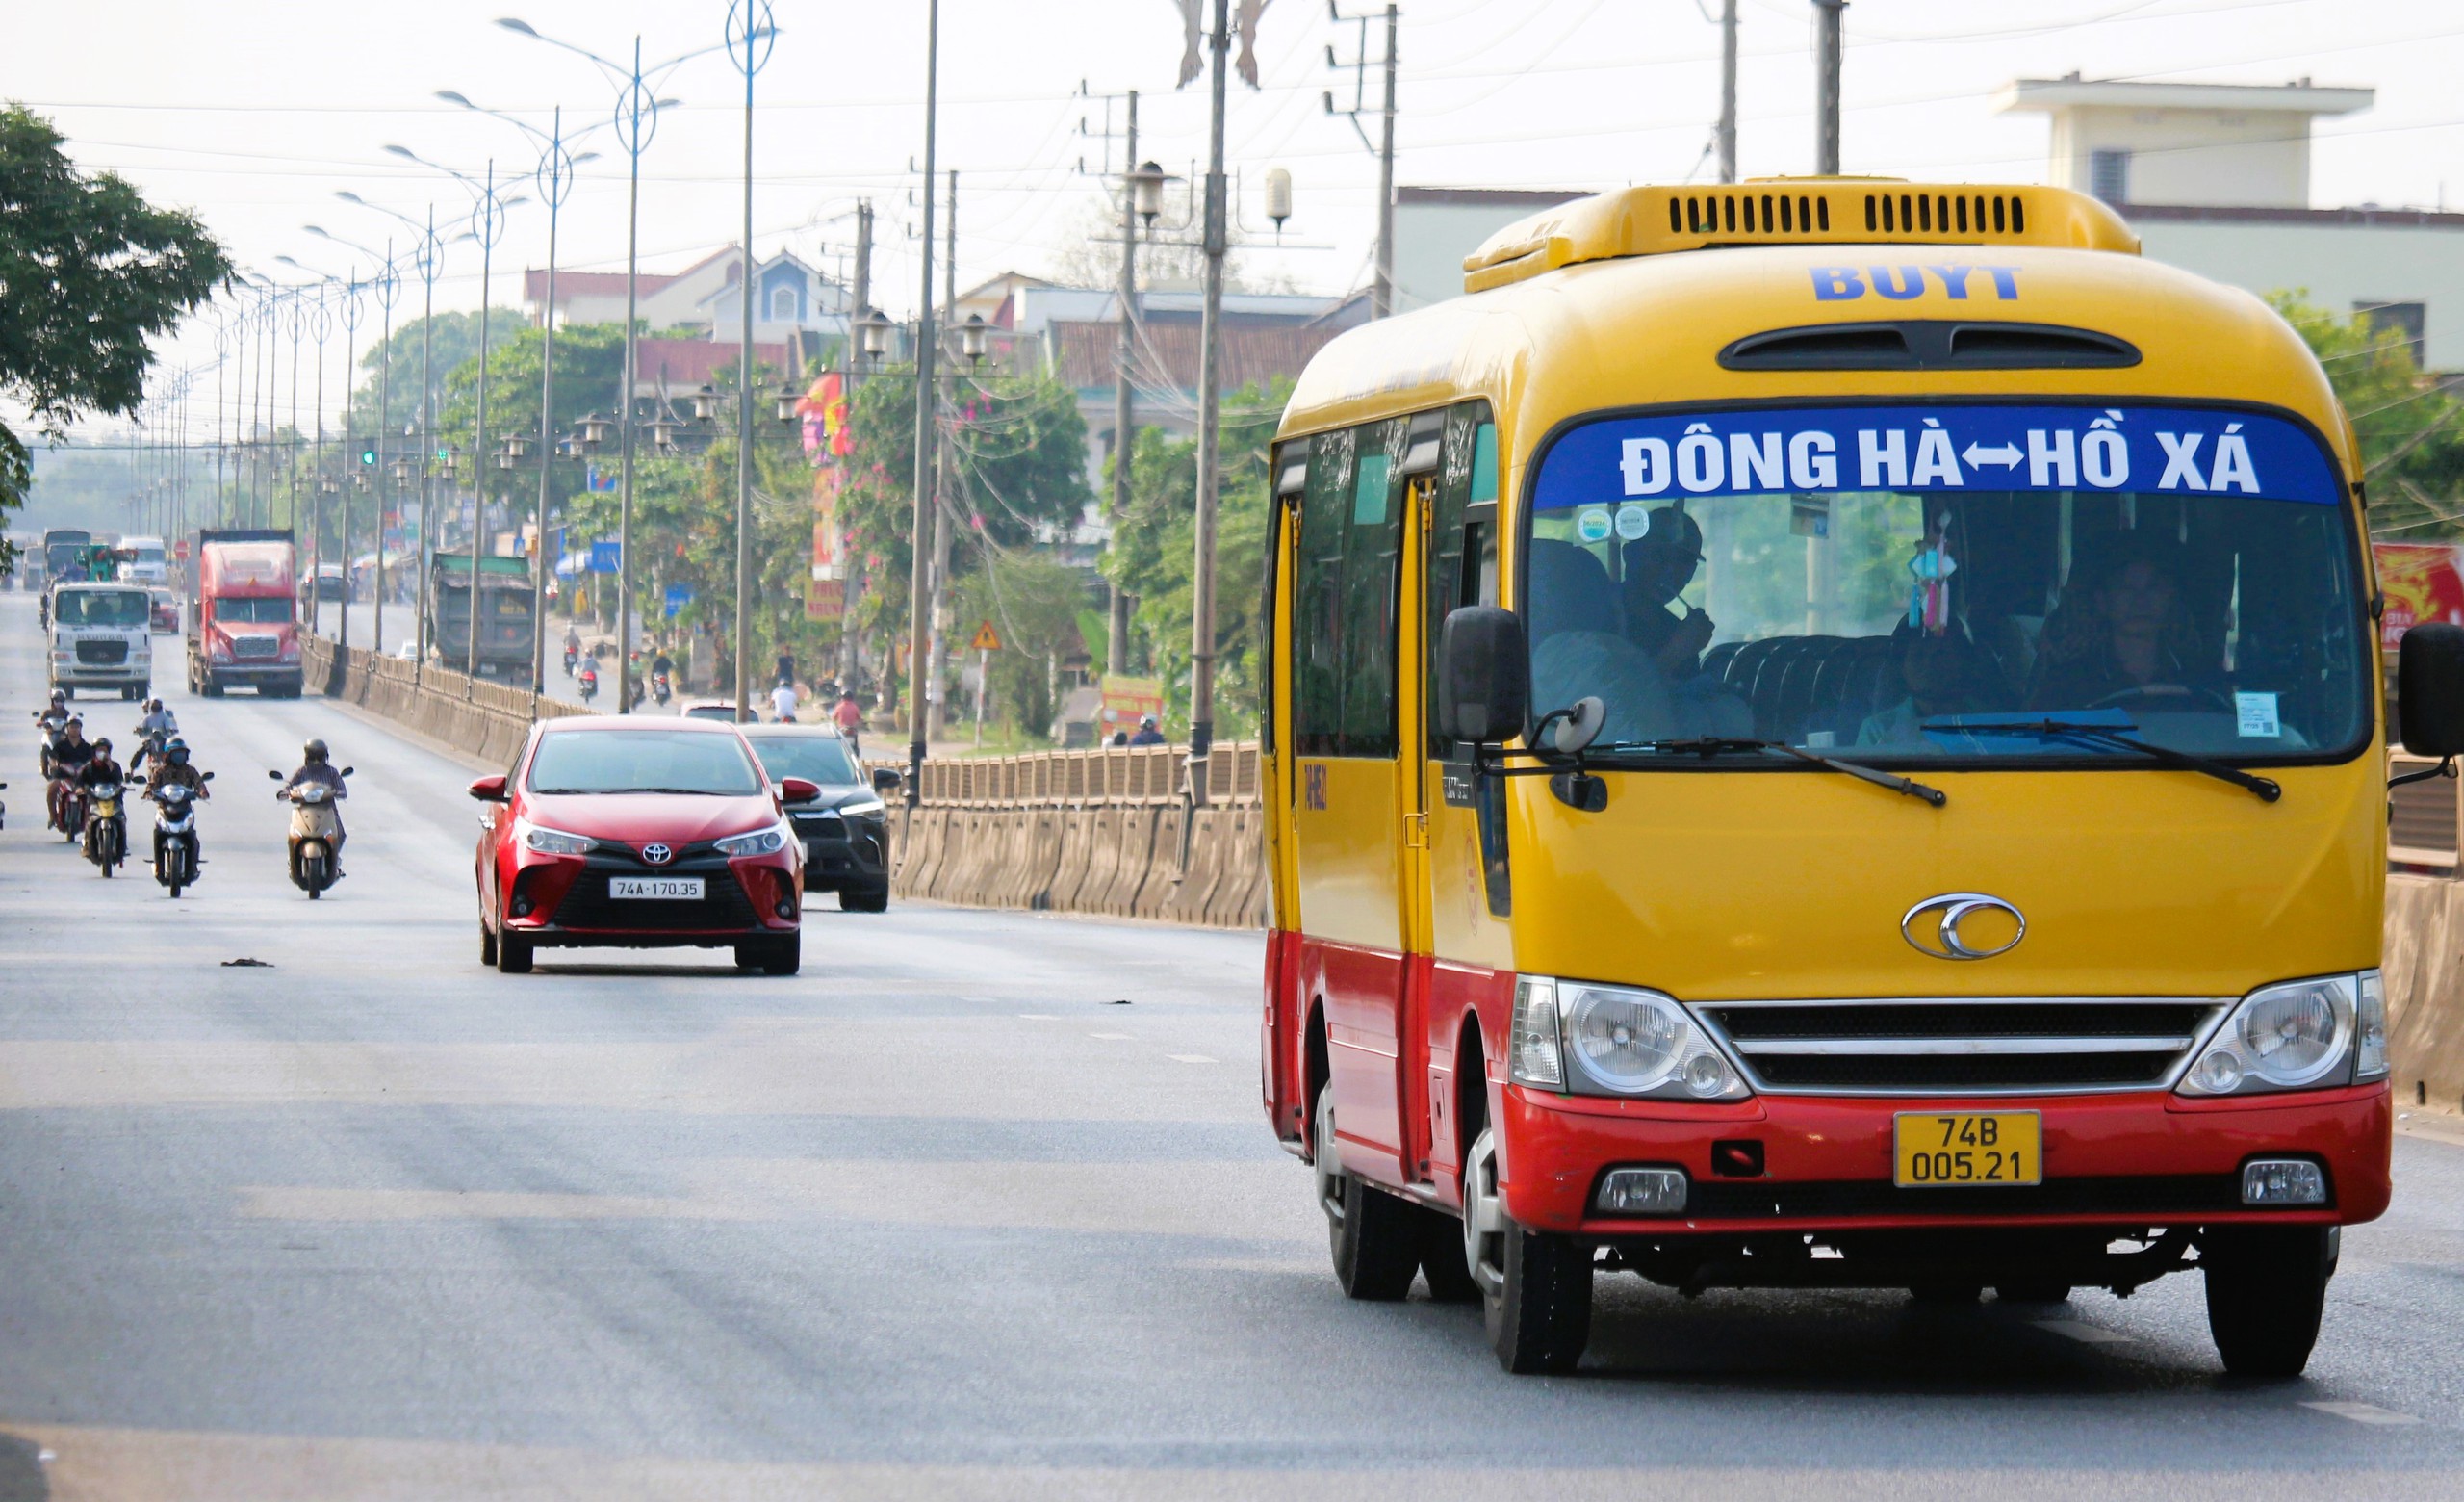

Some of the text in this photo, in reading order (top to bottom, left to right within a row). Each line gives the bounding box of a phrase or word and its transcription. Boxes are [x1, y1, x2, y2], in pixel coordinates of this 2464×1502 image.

[1620, 409, 2261, 496] ĐÔNG HÀ HỒ XÁ
[1938, 1117, 1998, 1148] 74B
[1912, 1151, 2020, 1181] 005.21
